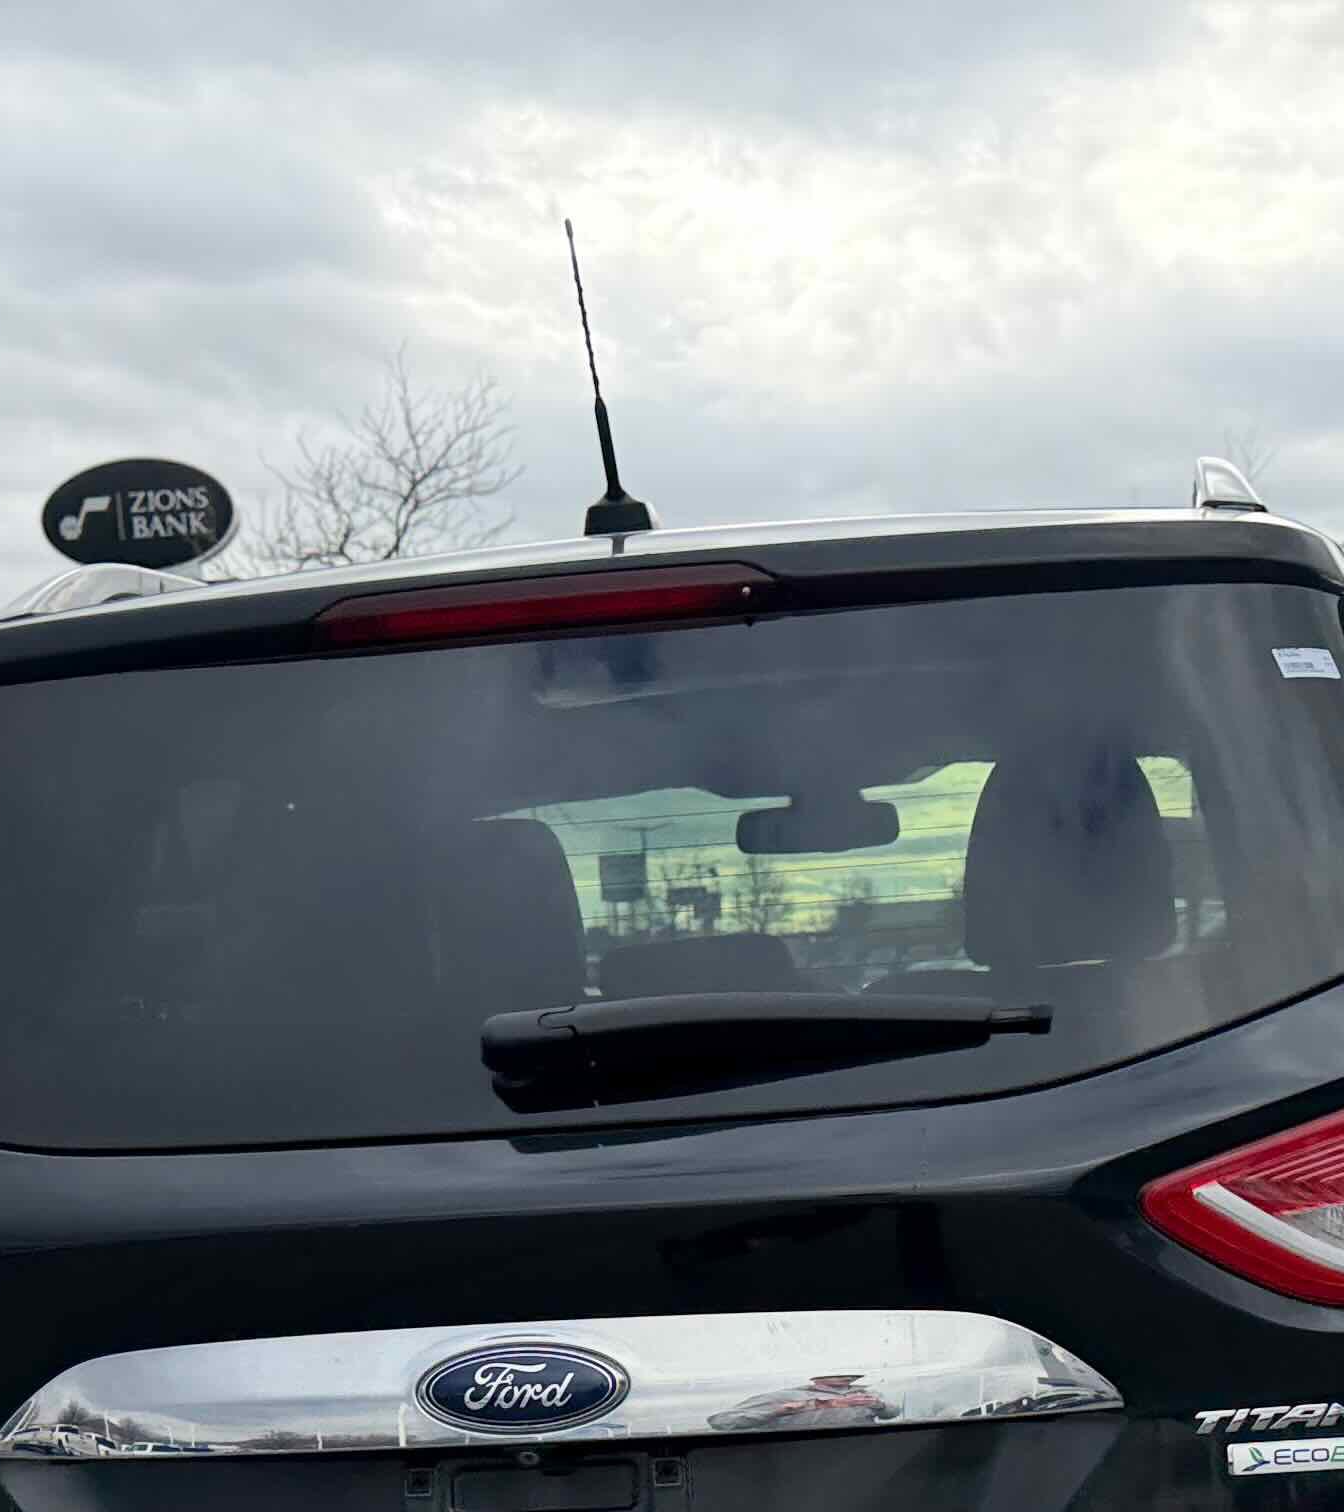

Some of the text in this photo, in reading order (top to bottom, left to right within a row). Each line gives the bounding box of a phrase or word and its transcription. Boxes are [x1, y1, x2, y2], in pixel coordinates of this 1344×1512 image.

[128, 487, 210, 514] ZIONS
[132, 511, 208, 540] BANK
[463, 1362, 575, 1411] Ford
